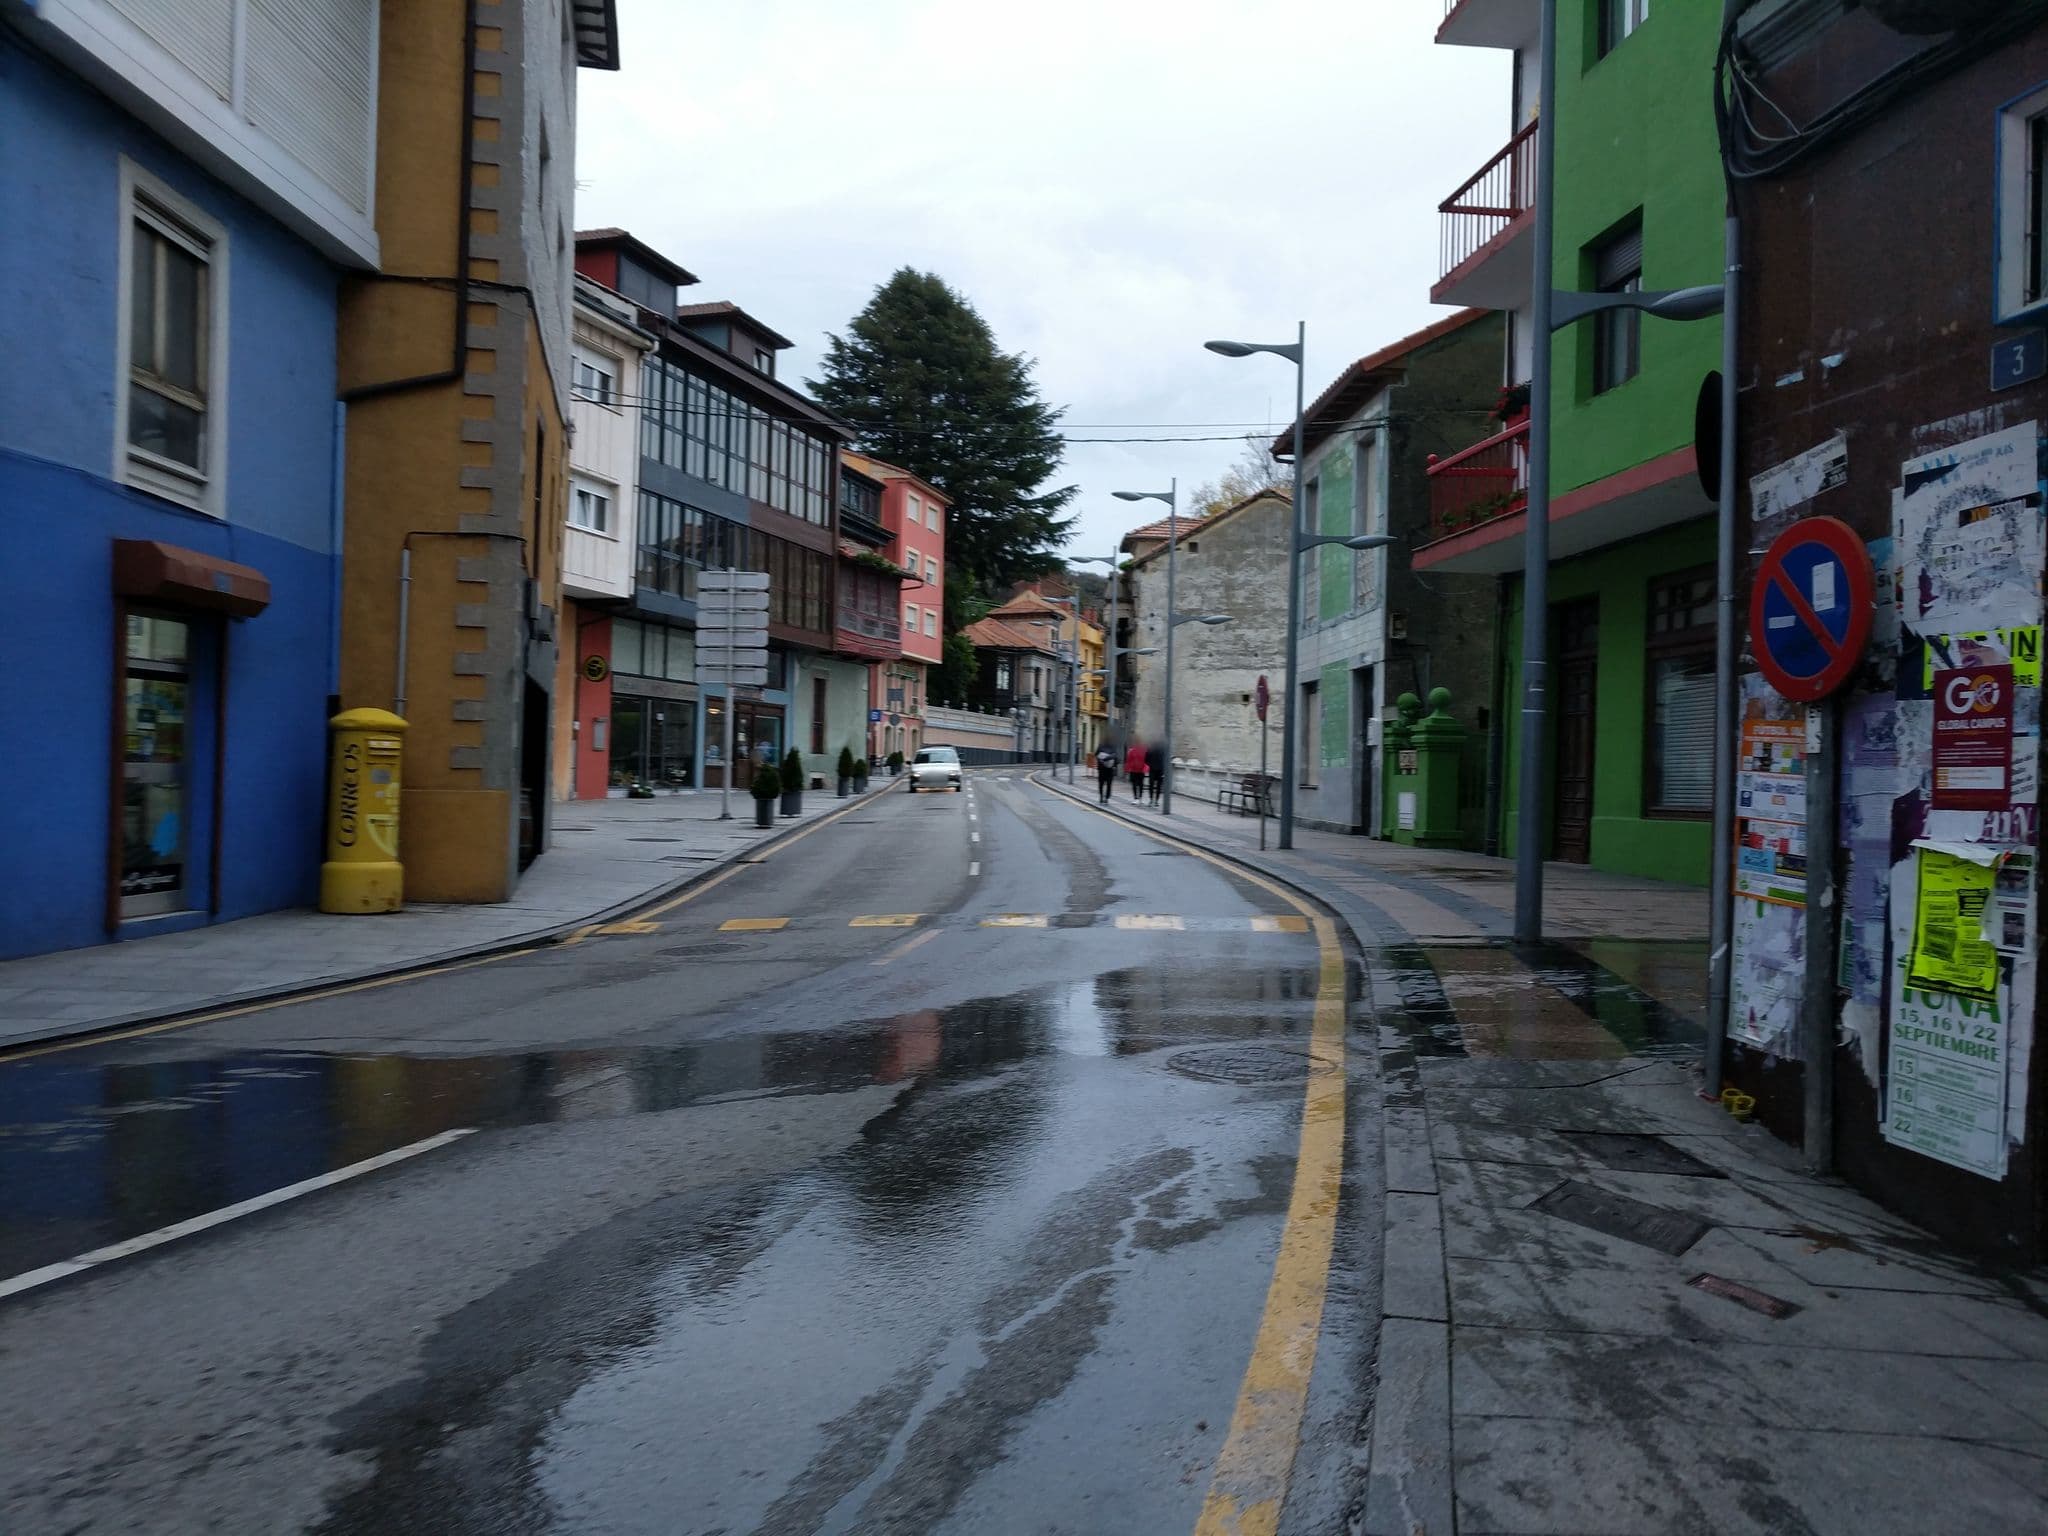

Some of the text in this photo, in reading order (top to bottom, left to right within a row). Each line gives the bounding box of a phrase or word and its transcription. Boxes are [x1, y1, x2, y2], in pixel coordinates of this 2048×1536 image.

[2013, 345, 2024, 375] 3
[1937, 718, 2006, 730] GLOBAL CAMPUS
[338, 743, 361, 847] CORREOS
[1932, 1015, 1951, 1031] 16
[1958, 1021, 1967, 1035] Y
[1974, 1024, 1997, 1042] 22
[1894, 1023, 2001, 1063] SEPTIEMBRE
[1897, 1059, 1913, 1074] 15
[1896, 1087, 1912, 1103] 16
[1894, 1117, 1911, 1134] 22
